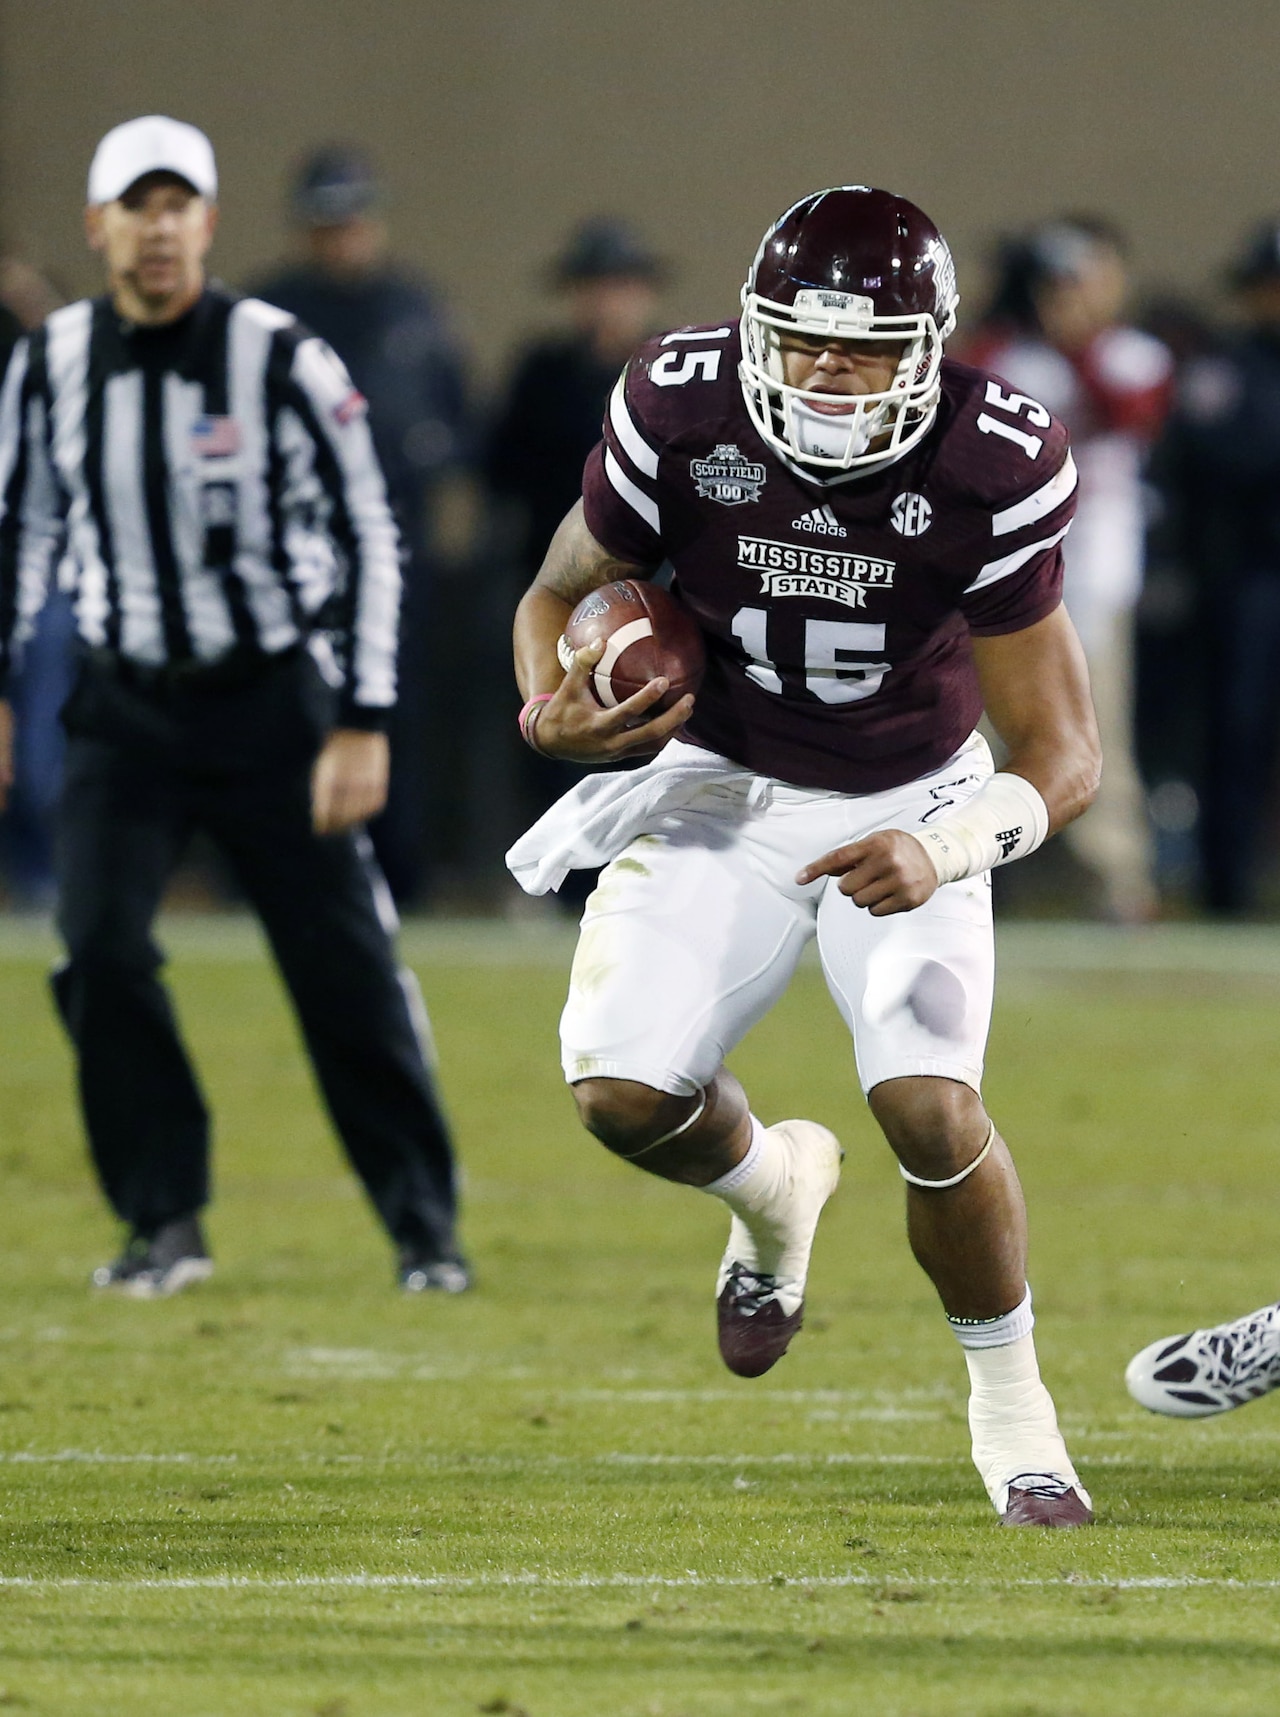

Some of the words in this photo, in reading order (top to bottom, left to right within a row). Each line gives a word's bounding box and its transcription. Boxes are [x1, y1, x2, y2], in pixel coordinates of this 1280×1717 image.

[650, 327, 731, 387] 15
[977, 379, 1053, 461] 15
[695, 463, 728, 477] SCOTT
[729, 466, 761, 481] FIELD
[715, 484, 742, 500] 100
[791, 519, 848, 538] adidas
[889, 492, 933, 537] SEC
[737, 540, 896, 584] MISSISSIPPI
[778, 578, 849, 602] STATE
[731, 607, 893, 705] 15
[995, 826, 1023, 843] adidas
